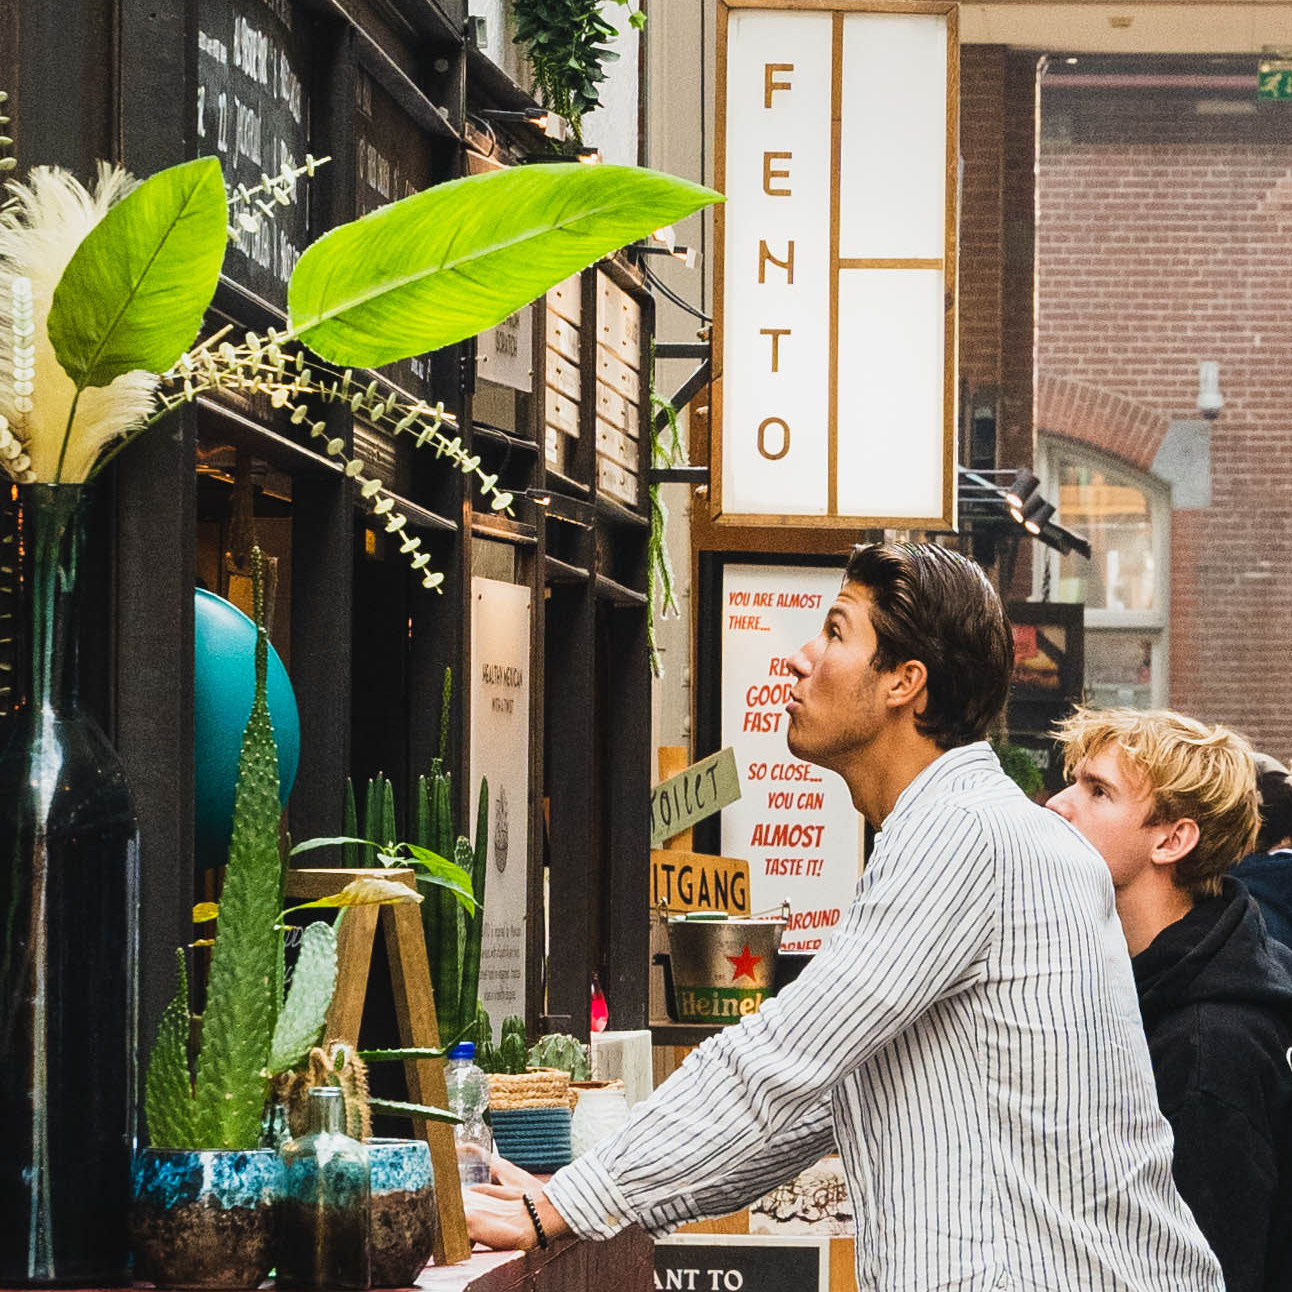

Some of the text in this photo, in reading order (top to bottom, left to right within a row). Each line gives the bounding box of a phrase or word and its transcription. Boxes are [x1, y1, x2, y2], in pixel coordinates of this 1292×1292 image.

[757, 63, 795, 461] FENTO
[729, 592, 822, 608] YOU ARE ALMOST
[743, 711, 782, 733] FAST
[748, 763, 767, 780] SO
[767, 792, 824, 810] YOU CAN
[750, 824, 825, 848] ALMOST
[764, 859, 824, 877] TASTE IT!
[783, 908, 840, 932] AROUND
[707, 1269, 743, 1291] TO
